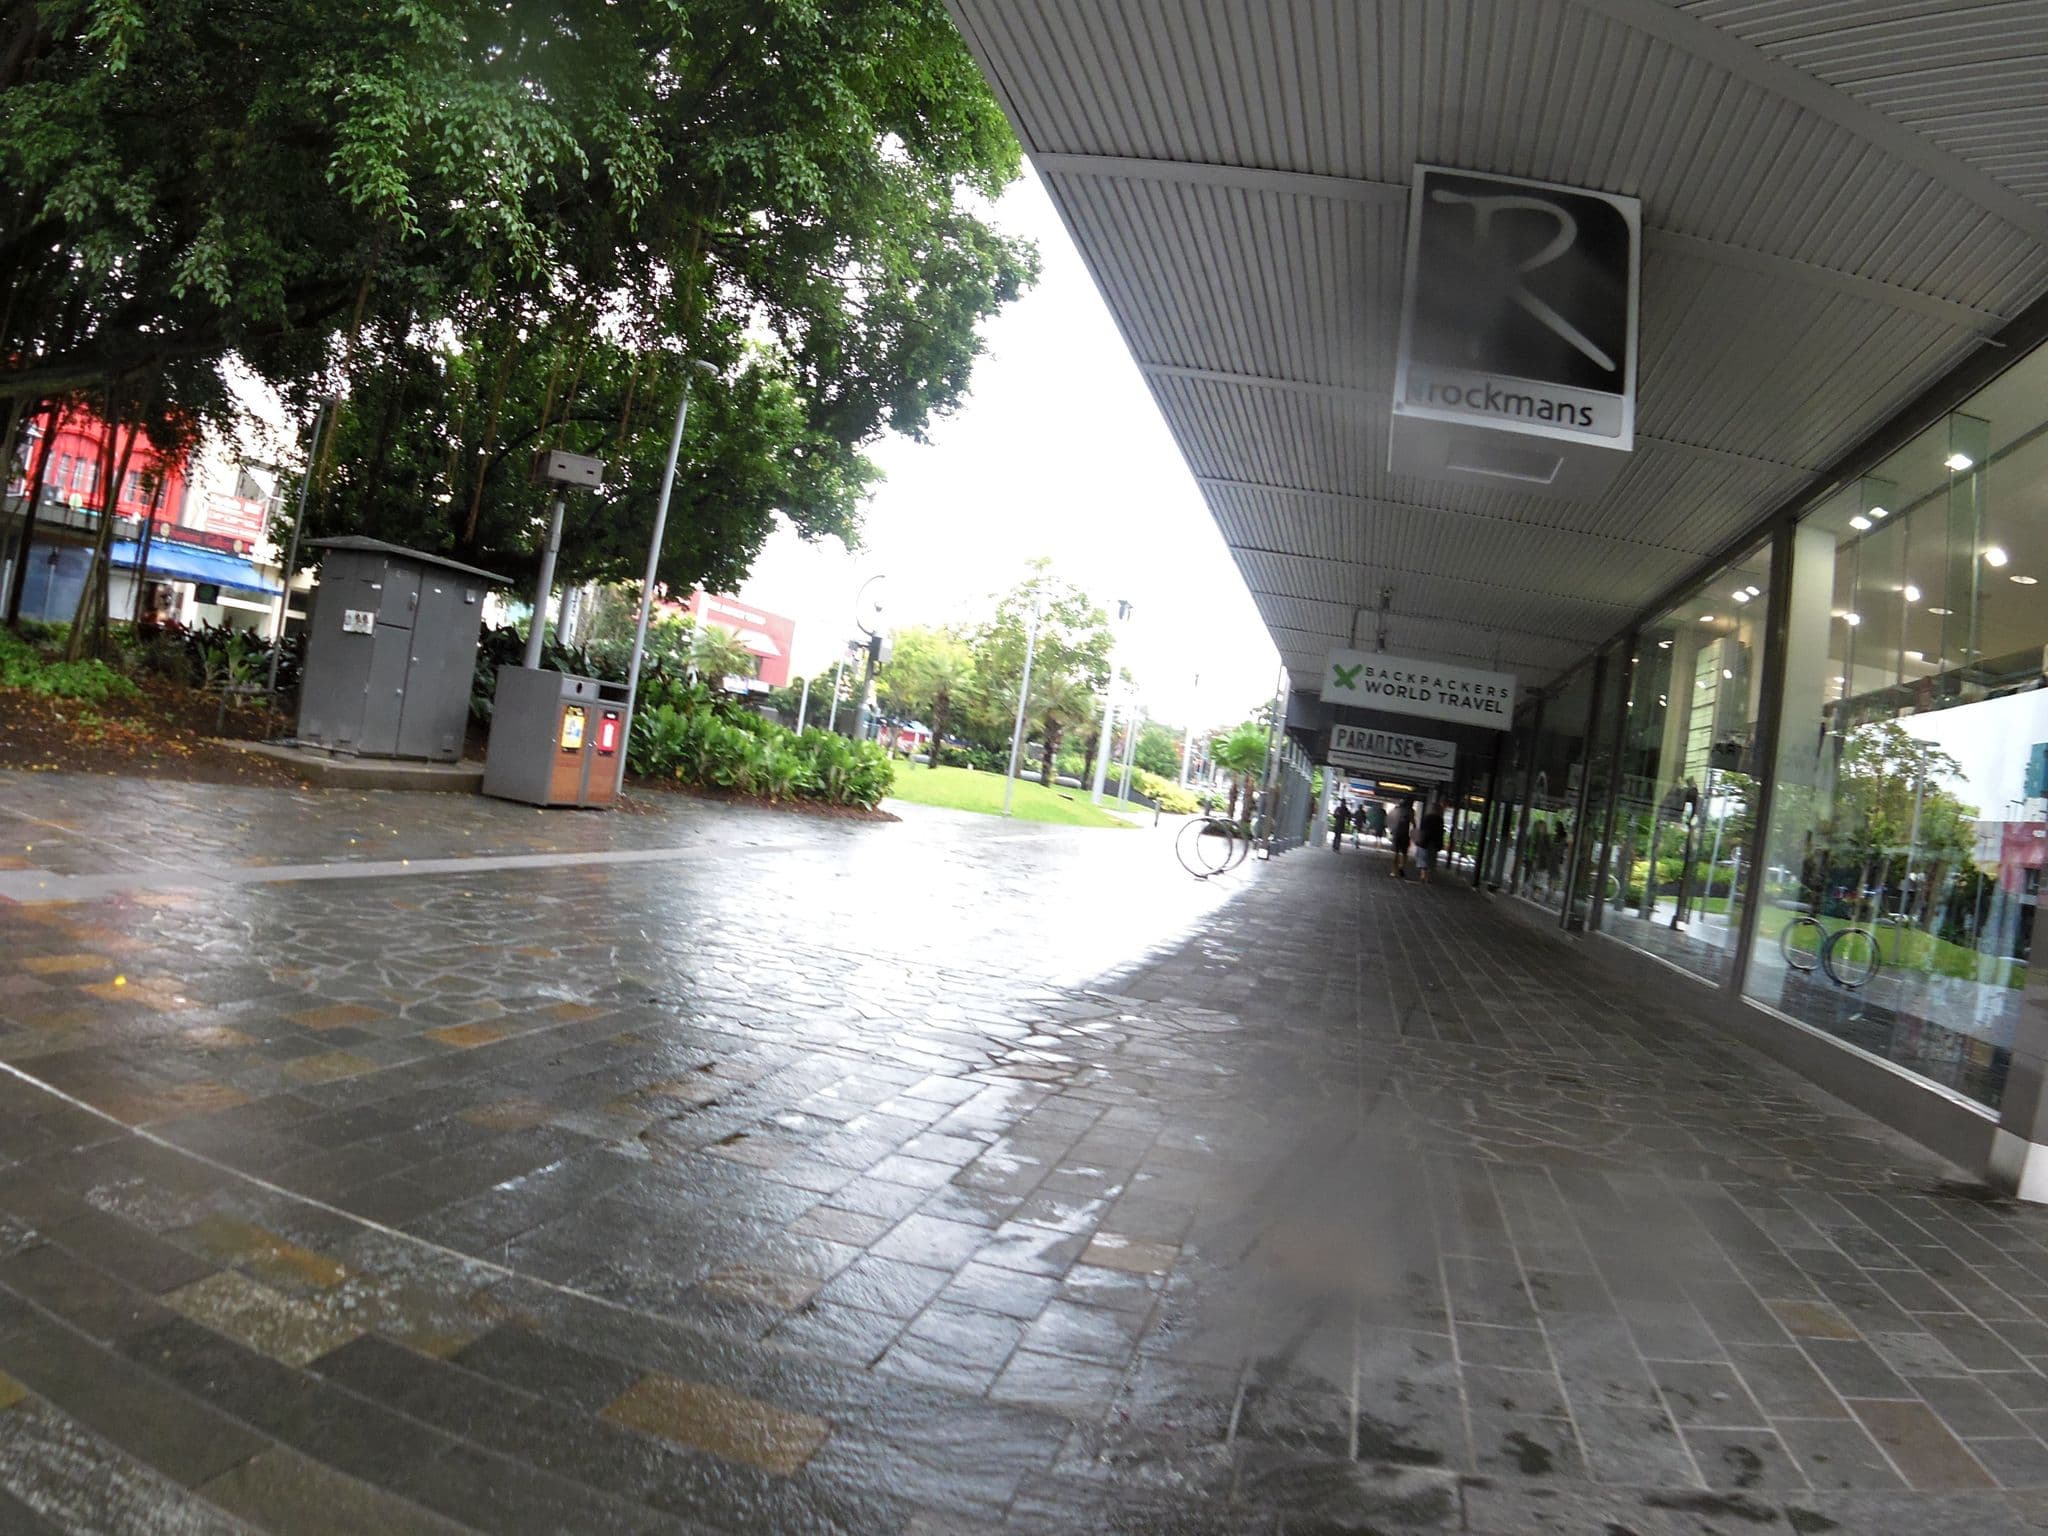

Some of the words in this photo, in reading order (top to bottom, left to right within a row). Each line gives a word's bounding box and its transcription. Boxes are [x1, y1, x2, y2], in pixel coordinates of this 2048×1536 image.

[1427, 380, 1595, 428] rockmans
[1364, 680, 1431, 702] WORLD
[1438, 691, 1504, 714] TRAVEL
[1365, 667, 1510, 698] BACKPACKERS
[1337, 729, 1414, 757] PARADISE
